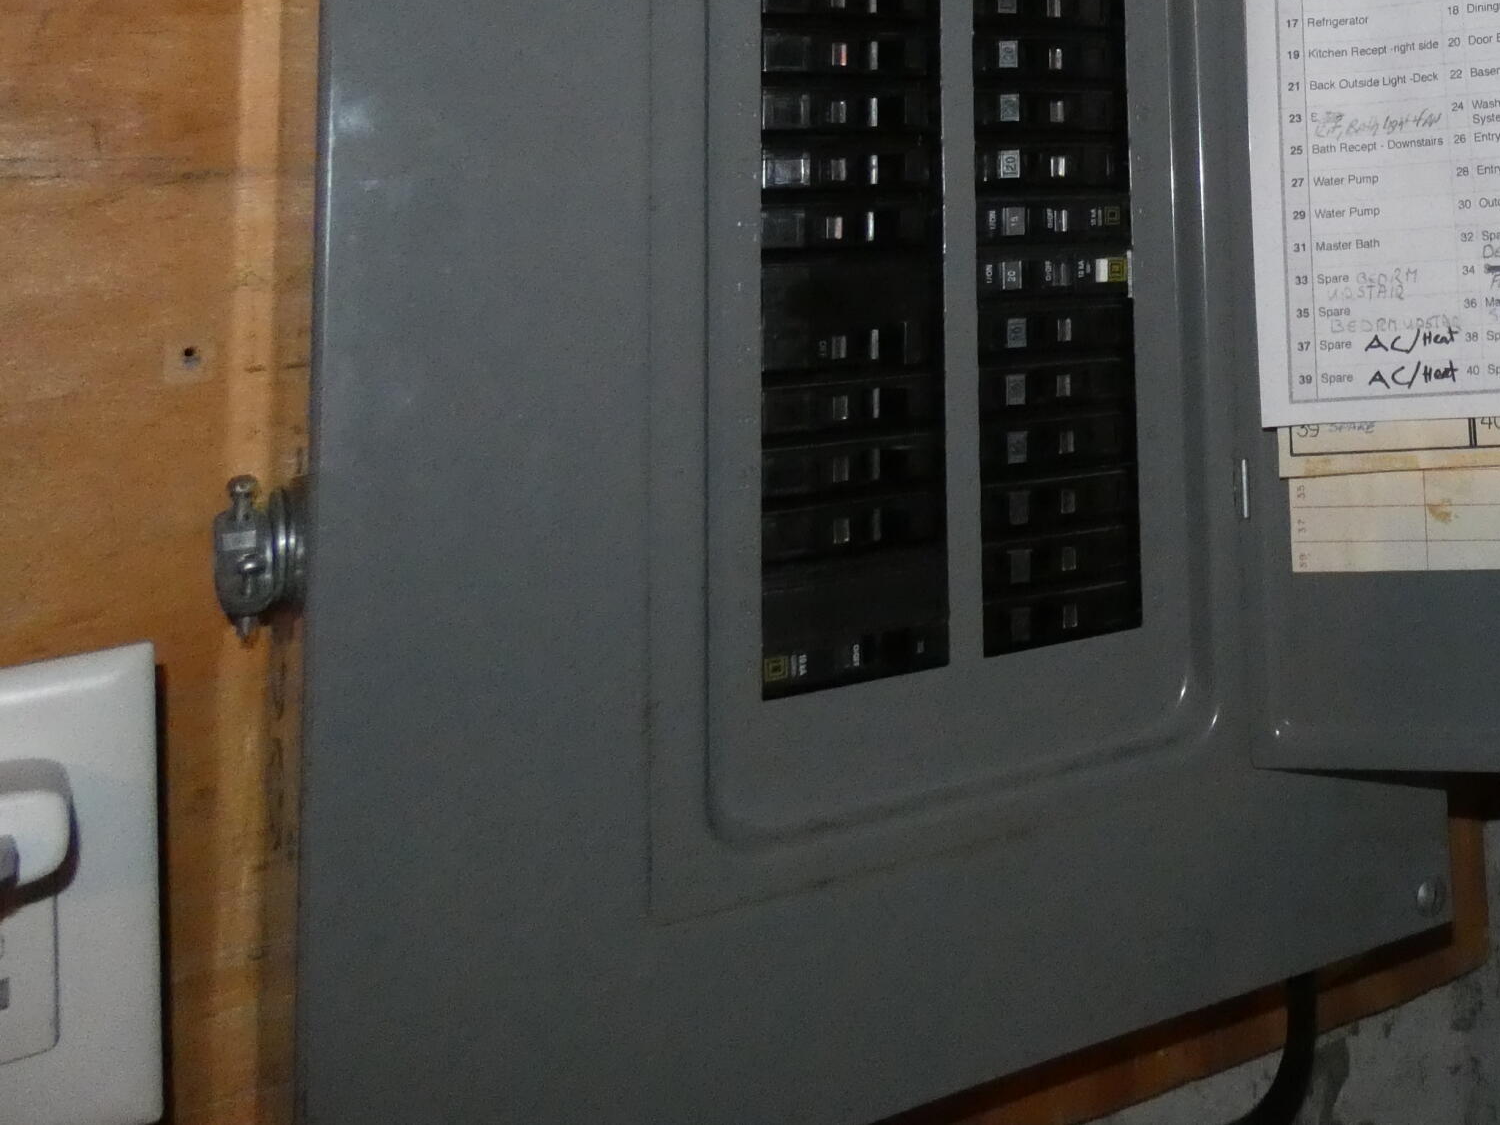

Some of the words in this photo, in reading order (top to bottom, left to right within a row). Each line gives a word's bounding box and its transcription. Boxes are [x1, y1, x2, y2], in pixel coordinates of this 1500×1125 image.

[1448, 6, 1459, 15] 18
[1286, 19, 1298, 28] 17
[1307, 17, 1369, 29] Refrigerator
[1448, 38, 1460, 47] 20
[1468, 34, 1493, 45] Door
[1288, 51, 1300, 59] 19
[1309, 49, 1347, 58] Kitchen
[1351, 46, 1387, 56] Recept
[1419, 40, 1439, 50] side
[1450, 69, 1462, 79] 22
[1288, 82, 1300, 91] 21
[1310, 79, 1335, 90] Back
[1339, 77, 1379, 89] Outside
[1383, 73, 1406, 86] Light
[1451, 102, 1464, 112] 24
[1289, 114, 1302, 123] 23
[1454, 134, 1466, 144] 26
[1290, 146, 1303, 155] 25
[1312, 143, 1336, 154] Bath
[1340, 141, 1377, 153] Recept
[1387, 137, 1444, 150] Downstairs
[1456, 167, 1469, 176] 28
[1291, 178, 1304, 187] 27
[1313, 175, 1344, 186] Water
[1349, 174, 1379, 185] Pump
[1458, 200, 1471, 209] 30
[1293, 210, 1306, 220] 29
[1315, 209, 1345, 219] Water
[1349, 206, 1380, 218] Pump
[1461, 232, 1474, 242] 32
[1294, 243, 1306, 252] 31
[1316, 240, 1351, 251] Master
[1356, 239, 1380, 249] Bath
[1462, 266, 1475, 275] 34
[1295, 276, 1308, 285] 33
[1317, 274, 1349, 285] Spare
[1464, 299, 1477, 309] 36
[1296, 309, 1309, 318] 35
[1319, 307, 1350, 318] Spare
[1465, 332, 1478, 342] 38
[1297, 341, 1311, 352] 37
[1320, 340, 1352, 352] Spare
[1466, 365, 1480, 375] 40
[1299, 375, 1313, 385] 39
[1321, 372, 1353, 385] Spare
